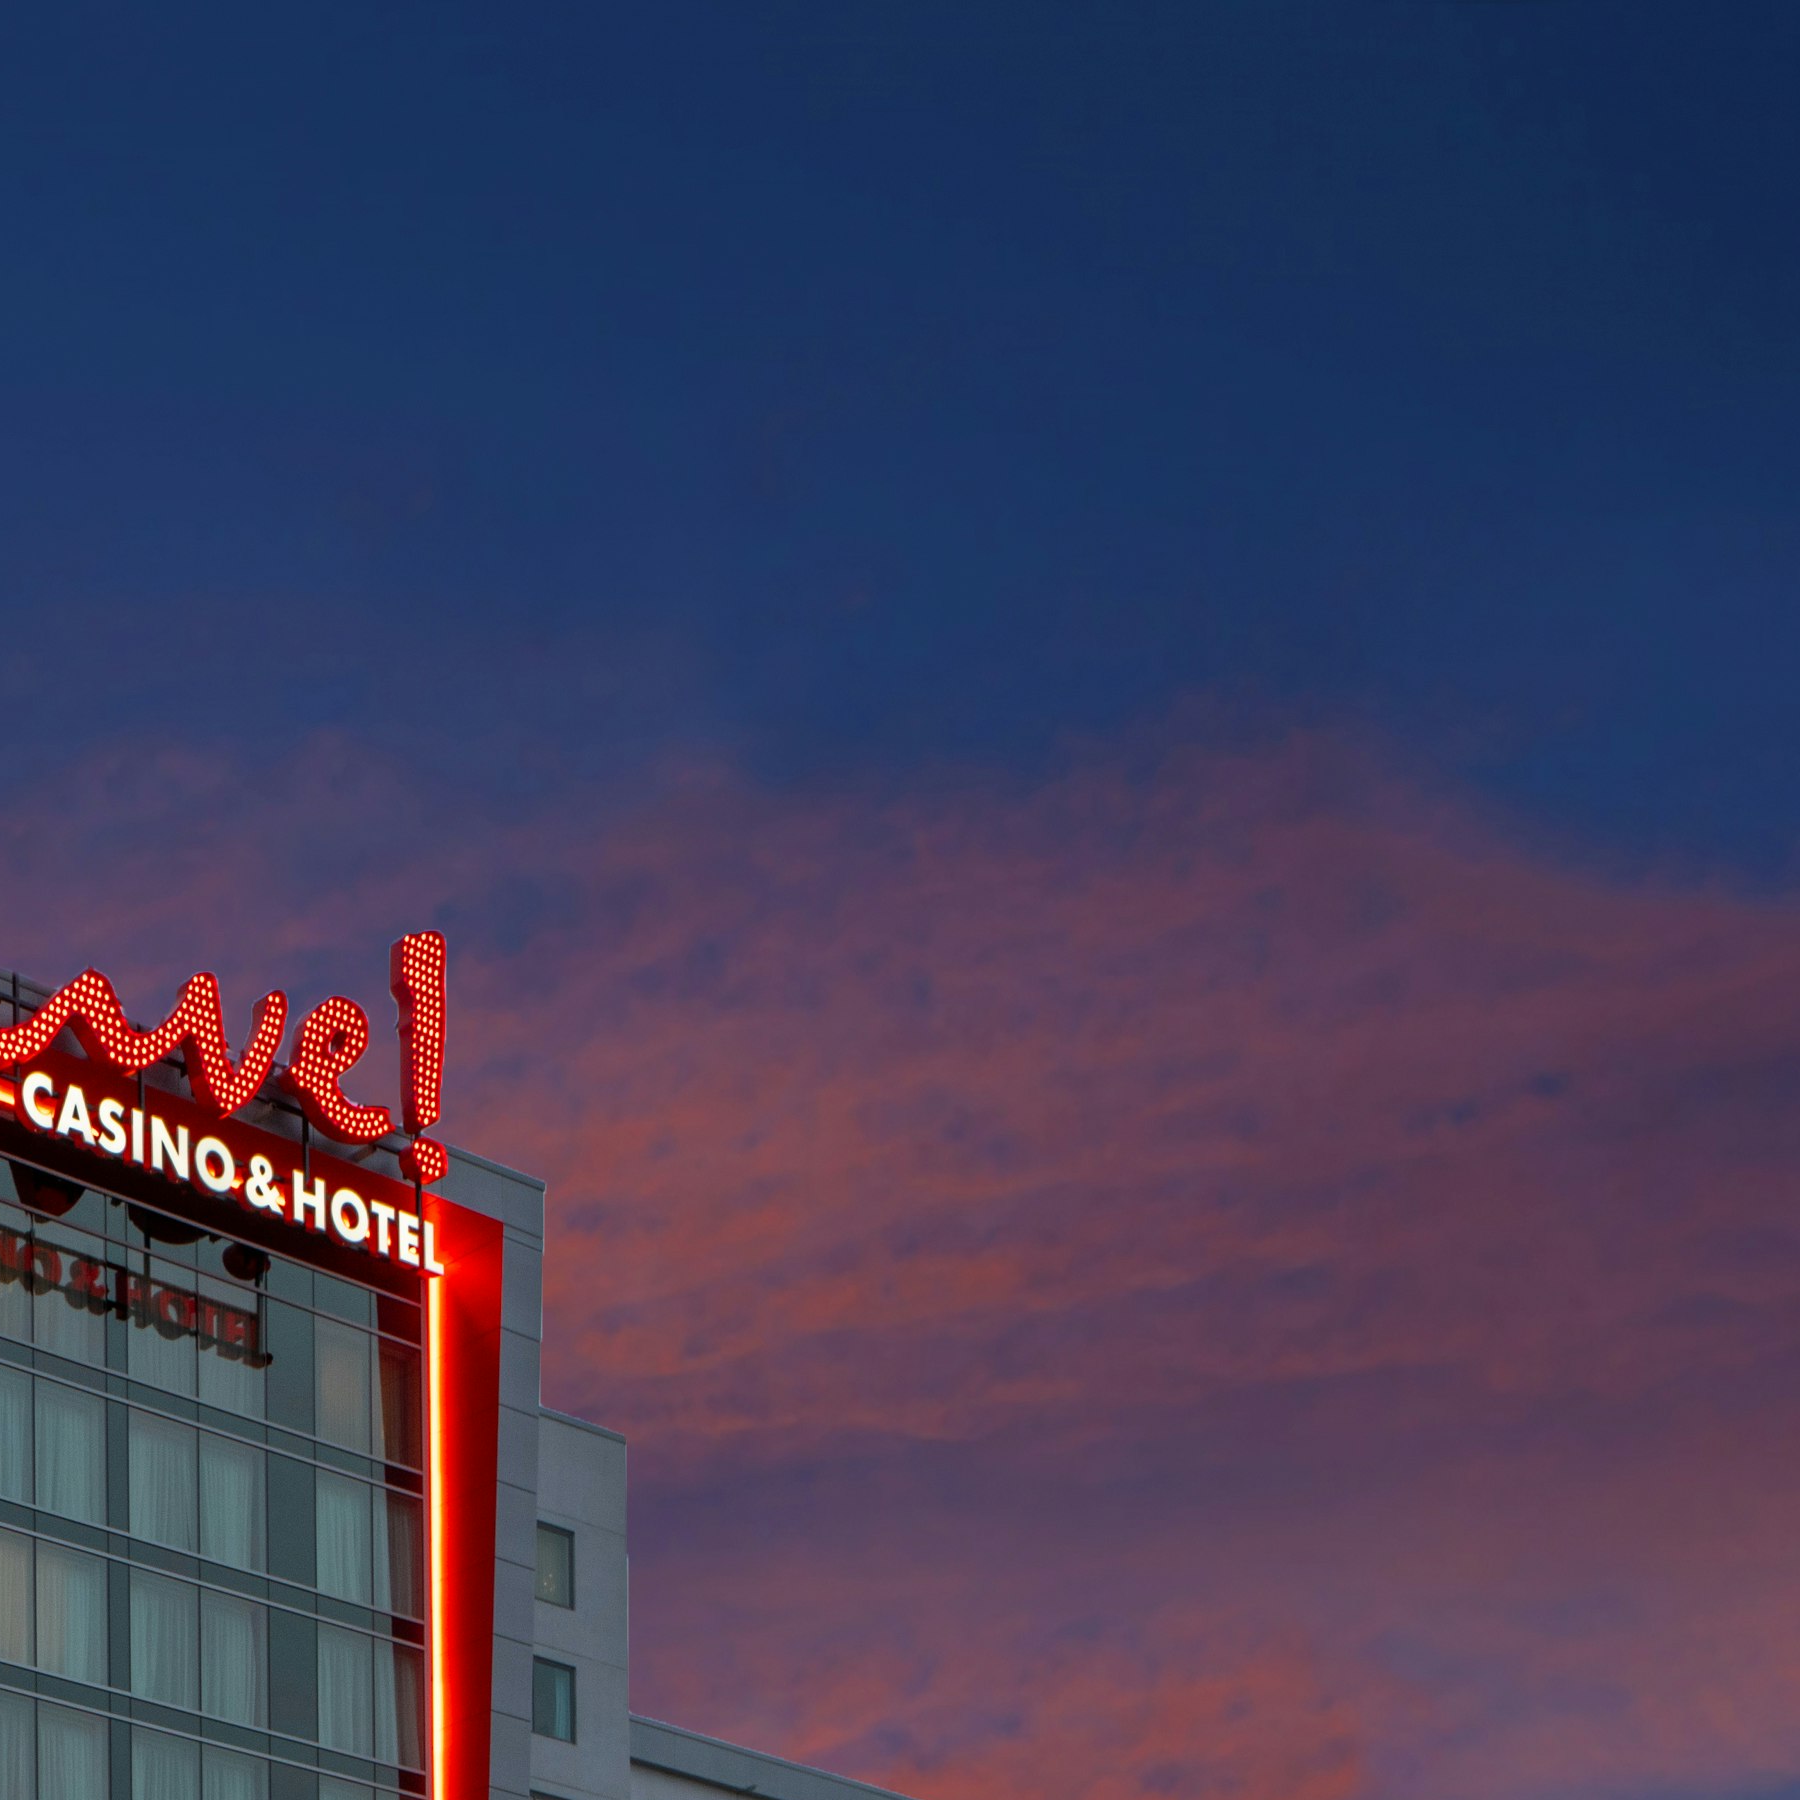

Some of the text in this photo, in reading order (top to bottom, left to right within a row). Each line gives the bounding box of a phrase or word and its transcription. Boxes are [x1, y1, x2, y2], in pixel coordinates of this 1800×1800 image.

[20, 1072, 445, 1277] CASINO & HOTEL
